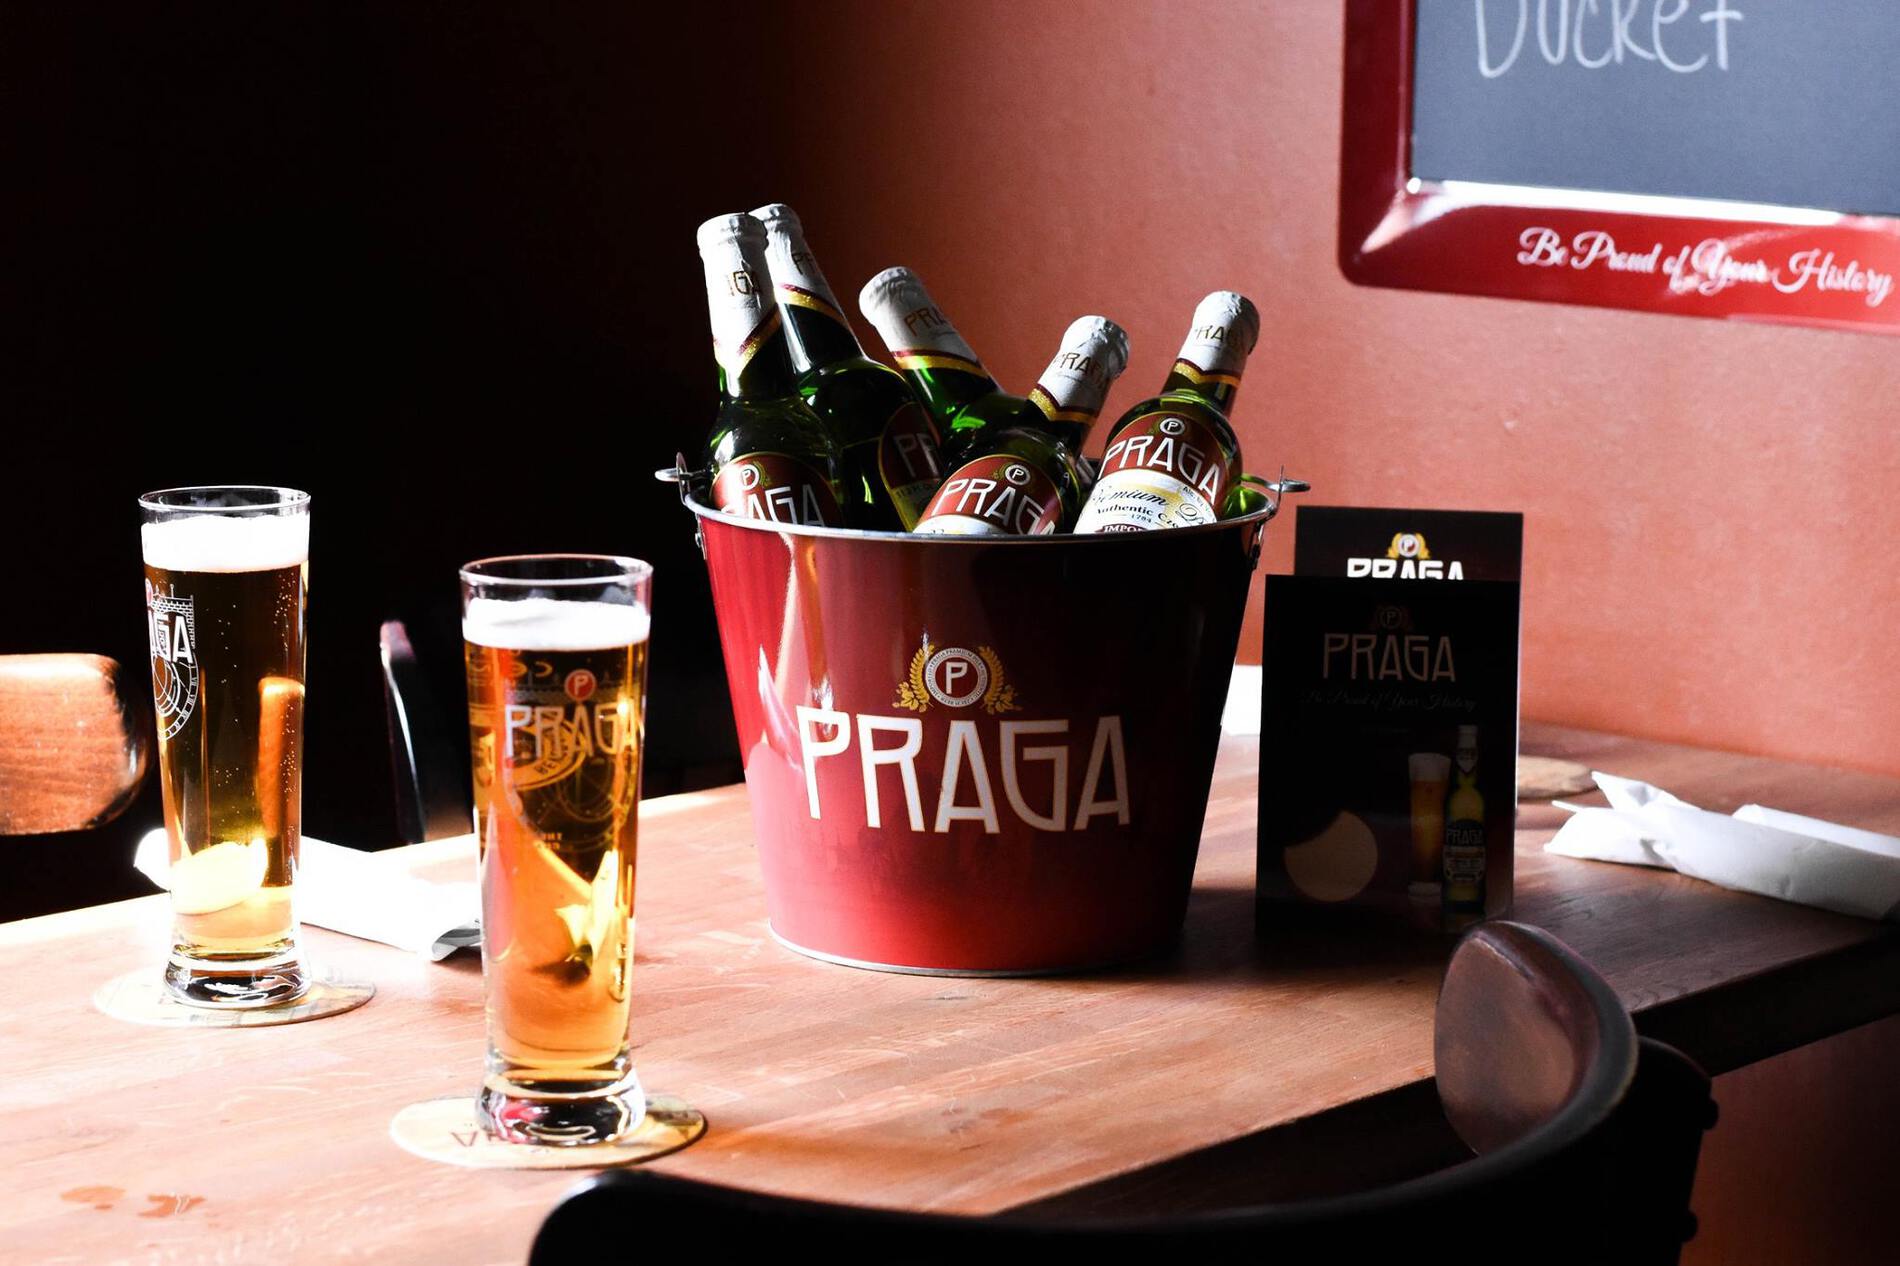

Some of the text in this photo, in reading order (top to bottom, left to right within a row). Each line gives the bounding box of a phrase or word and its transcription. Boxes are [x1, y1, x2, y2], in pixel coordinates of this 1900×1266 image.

[1517, 226, 1569, 268] Be
[1570, 231, 1663, 273] Proud
[1772, 248, 1893, 307] History
[1098, 435, 1220, 506] PRAGA
[946, 661, 969, 695] P
[1322, 632, 1457, 683] PRAGA
[796, 705, 1131, 834] PRAGA
